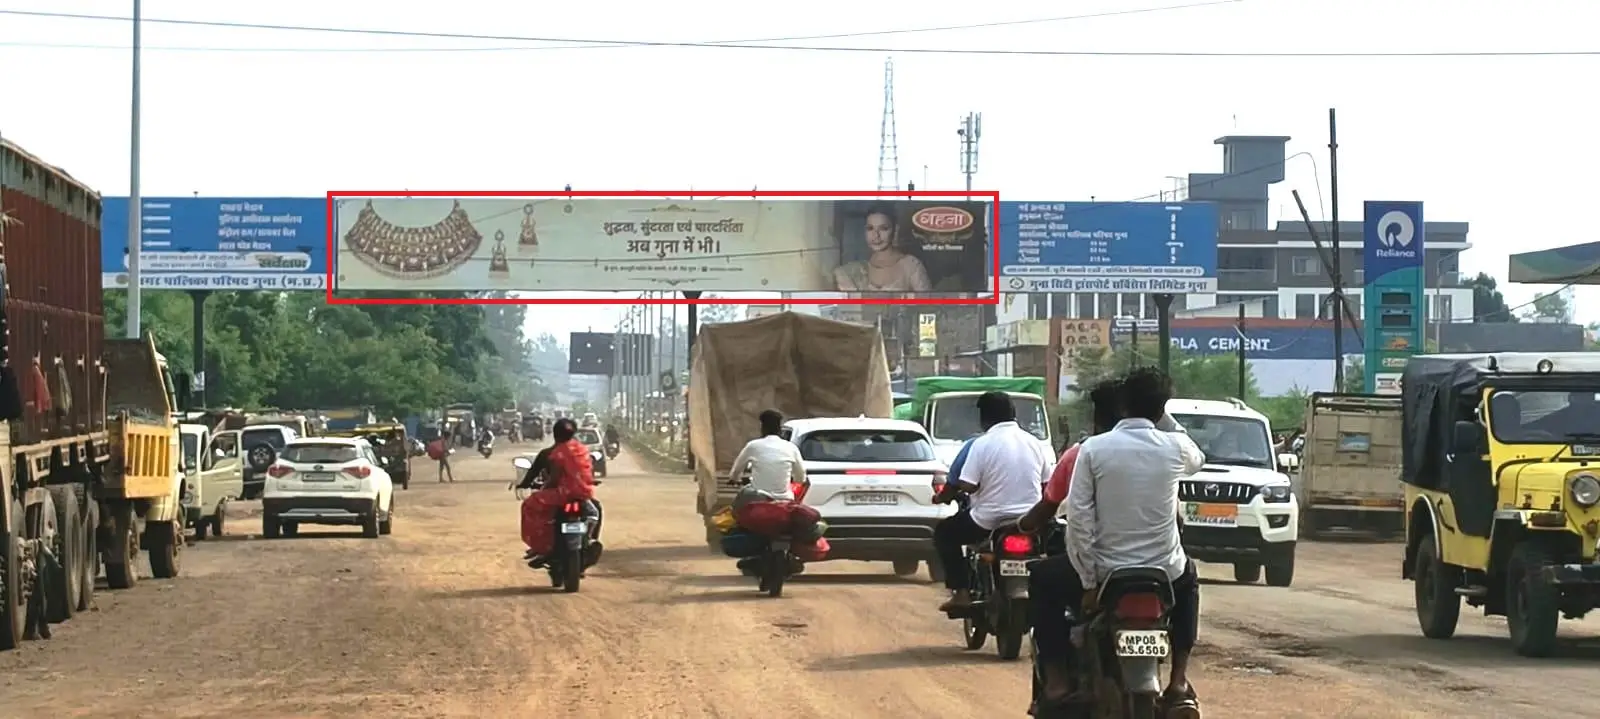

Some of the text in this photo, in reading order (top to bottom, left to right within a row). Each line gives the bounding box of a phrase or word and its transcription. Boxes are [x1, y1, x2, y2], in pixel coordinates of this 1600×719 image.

[603, 218, 744, 236] शुद्धता, सुंदरता एवं पारदर्शिता
[627, 236, 720, 257] अब गुना में भी।
[1376, 249, 1416, 258] Reliance
[164, 274, 208, 286] पालिका
[212, 274, 248, 286] परिषद
[253, 276, 276, 288] गुना
[281, 274, 324, 288] (म.प्र.)
[1030, 280, 1049, 291] गुना
[1051, 278, 1073, 289] सिटी
[1075, 278, 1110, 291] ट्रांसपोर्ट
[1149, 278, 1186, 290] लिमिटेड
[1188, 280, 1207, 292] गुना
[1208, 336, 1271, 351] CEMENT
[1125, 635, 1157, 646] MP08
